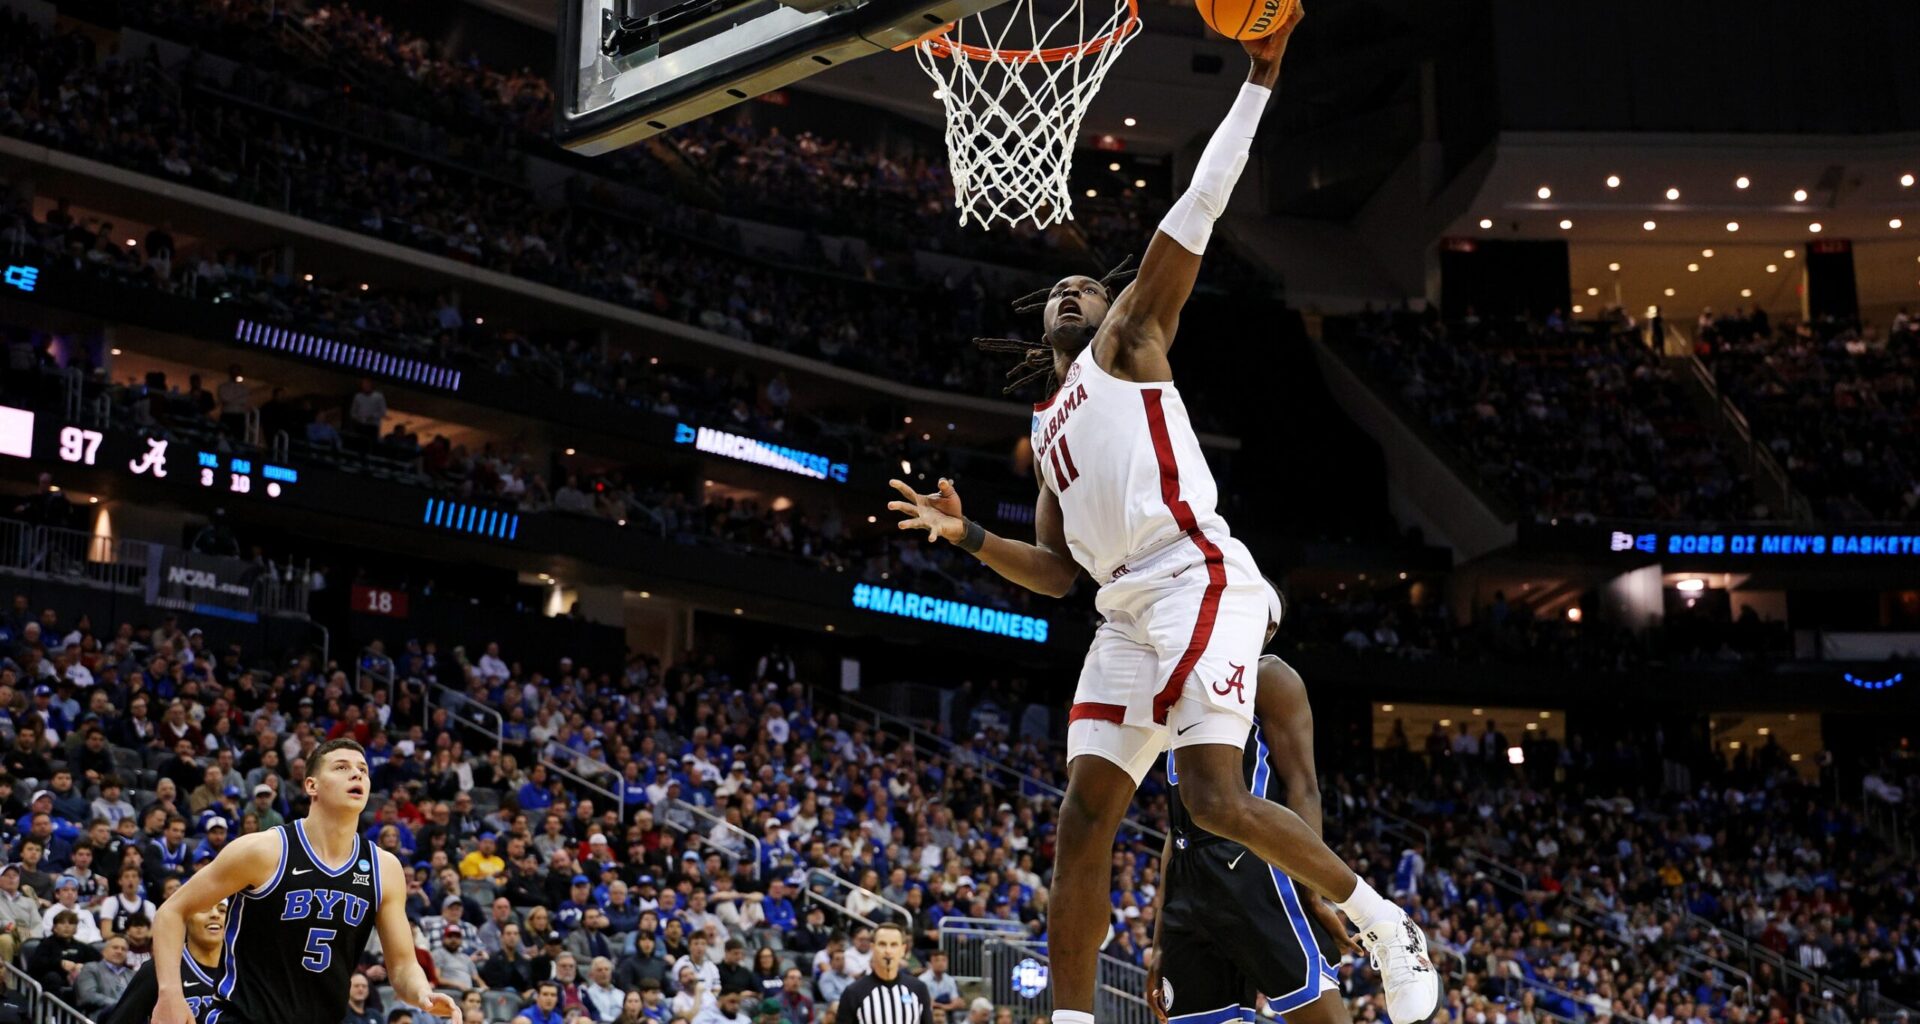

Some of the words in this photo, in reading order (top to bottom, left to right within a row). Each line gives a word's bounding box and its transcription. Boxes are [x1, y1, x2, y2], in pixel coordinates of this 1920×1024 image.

[59, 426, 103, 465] 97
[1050, 434, 1080, 493] 11
[230, 473, 251, 493] 10
[1668, 535, 1725, 554] 2025
[1761, 535, 1826, 554] MEN'S
[367, 590, 392, 614] 18
[852, 583, 1049, 643] #MARCHMADNESS
[280, 888, 370, 927] BYU
[302, 927, 337, 973] 5
